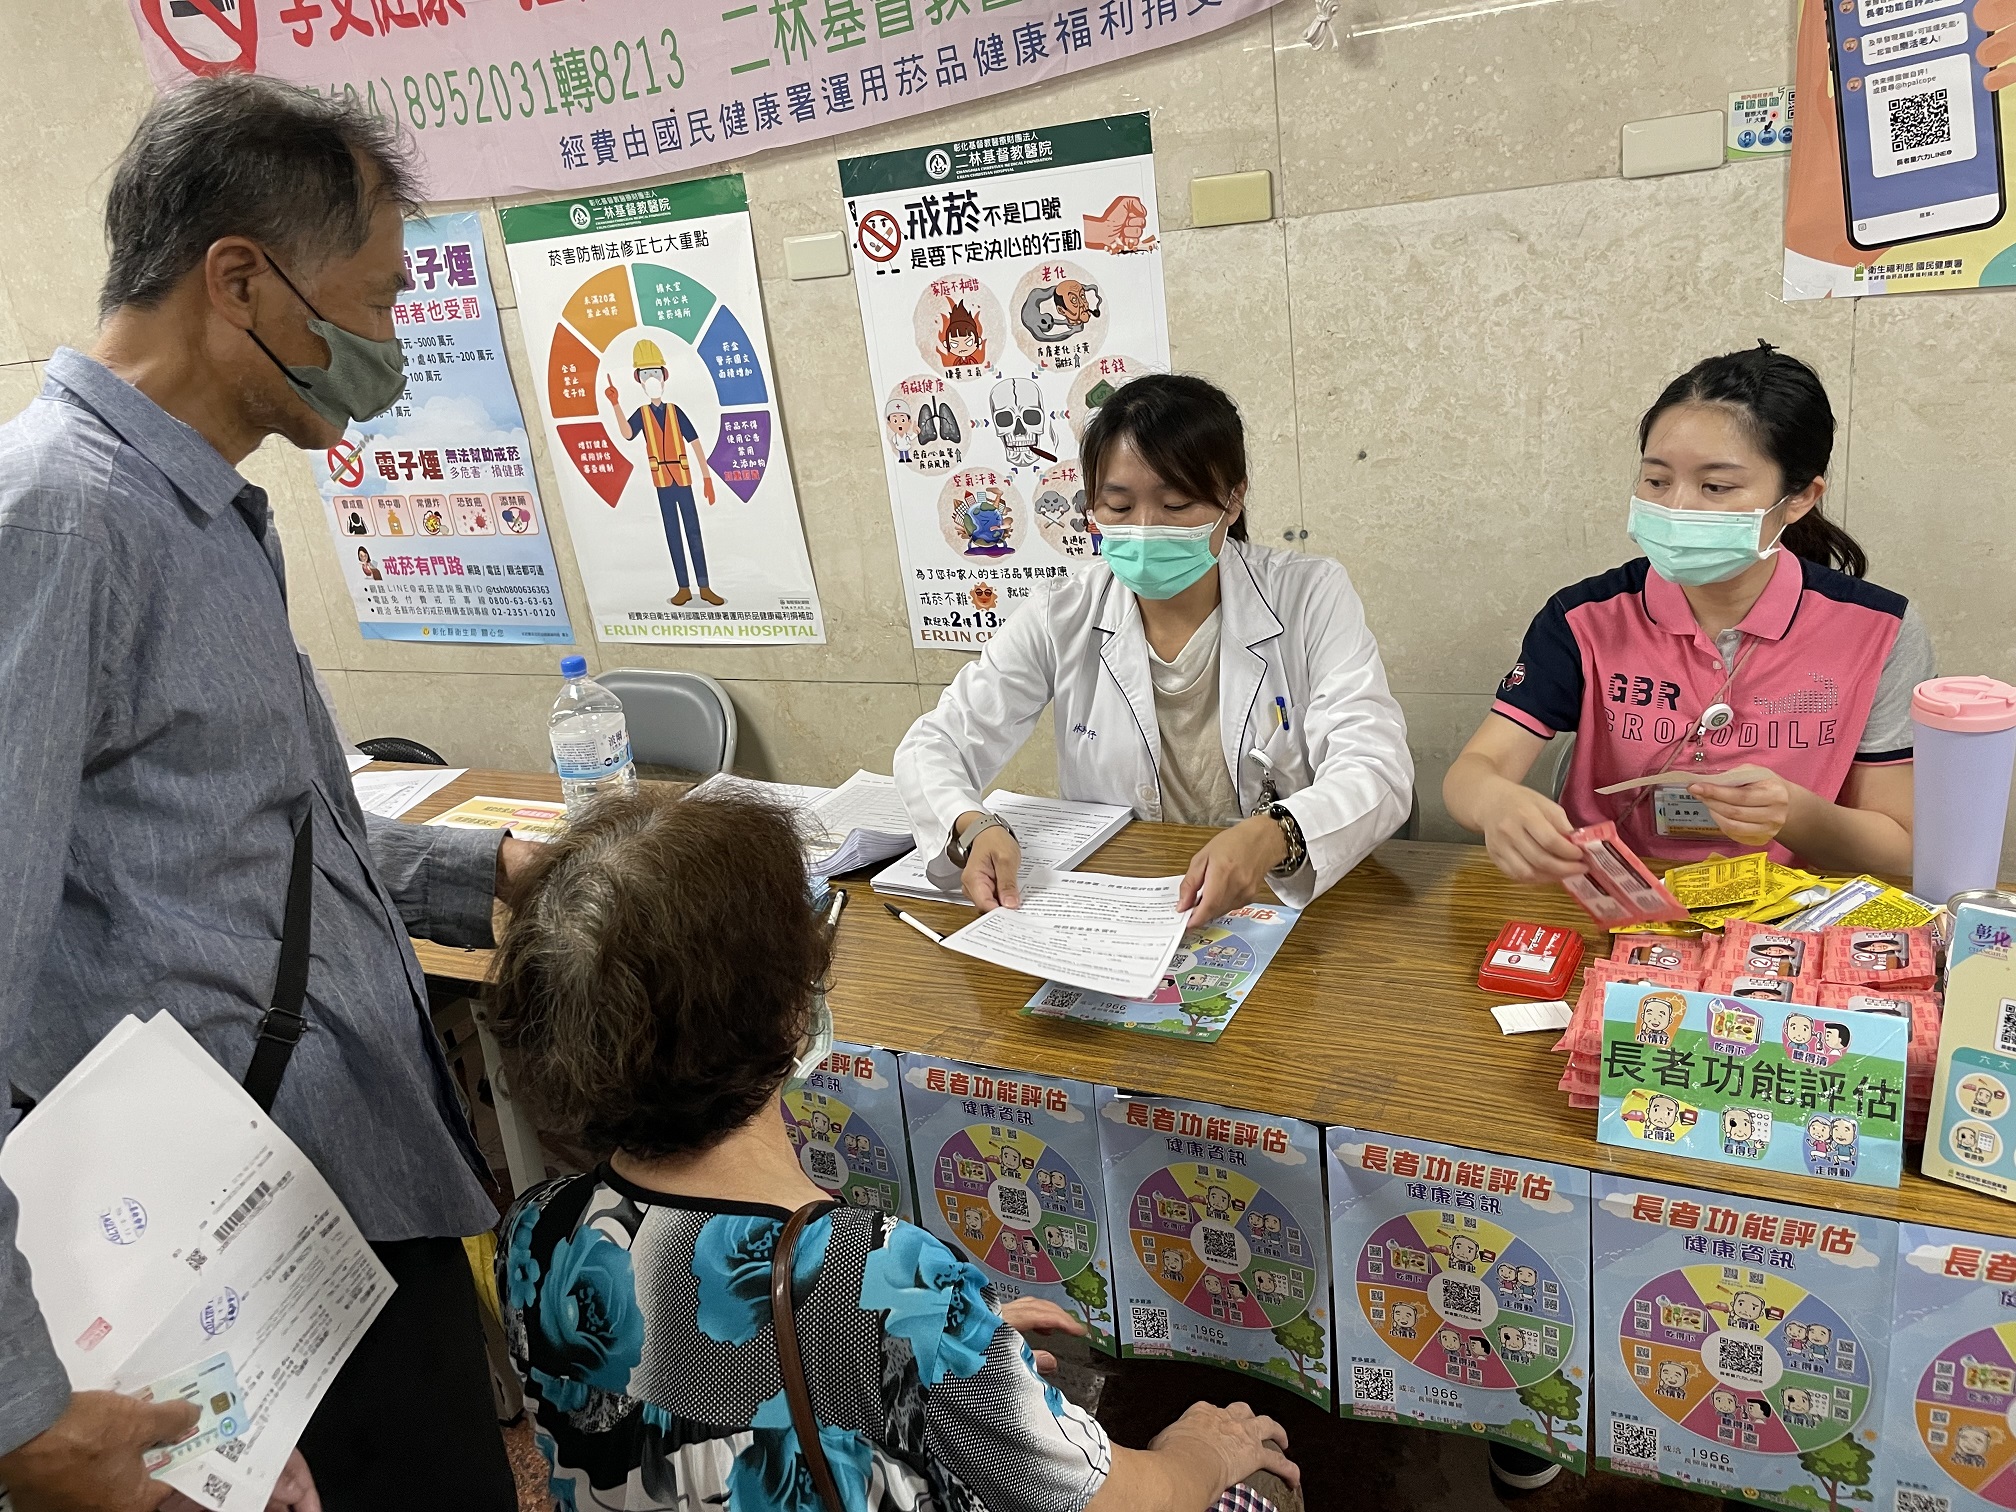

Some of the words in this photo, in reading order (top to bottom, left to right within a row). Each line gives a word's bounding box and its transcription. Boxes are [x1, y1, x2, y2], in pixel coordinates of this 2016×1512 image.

[954, 140, 1054, 170] 二林基督教醫院
[592, 197, 671, 220] 二林基督教醫院
[548, 229, 710, 267] 菸害防制法修正七大重點
[910, 229, 1082, 269] 是要下定決心的行動
[1042, 266, 1066, 282] 老化
[1868, 262, 1914, 274] 衛生福利部
[1916, 259, 1963, 271] 國民健康署
[930, 278, 980, 296] 家庭不和諧
[392, 297, 481, 325] 用者也受罰
[427, 353, 437, 364] 40
[1099, 358, 1127, 374] 花錢
[561, 364, 577, 374] 全面
[900, 378, 945, 395] 有礙健康
[445, 446, 521, 464] 無法幫助戒菸
[374, 449, 444, 481] 電子煙
[1051, 468, 1079, 482] 二手菸
[382, 556, 465, 576] 戒菸有門路
[488, 597, 553, 605] 0800-63-63-63
[919, 592, 969, 607] 戒菸不難
[491, 608, 556, 617] 02-2351-0120
[604, 625, 648, 636] ERLIN
[651, 625, 734, 637] CHRISTIAN
[738, 625, 818, 637] HOSPITAL
[920, 629, 972, 643] ERLIN
[1608, 673, 1681, 711] GBR
[1976, 924, 2011, 947] 彰化
[1100, 1002, 1128, 1011] 1966
[1636, 1032, 1670, 1046] 心情好
[1713, 1041, 1747, 1056] 吃得下
[1792, 1049, 1828, 1066] 聽得清
[1979, 1055, 2011, 1070] 六大
[1604, 1038, 1901, 1122] 長者功能評估
[926, 1067, 1069, 1113] 長者功能評估
[961, 1100, 1034, 1126] 健康資訊
[1126, 1102, 1288, 1155] 長者功能評估
[1642, 1129, 1676, 1141] 記得起
[1165, 1136, 1247, 1167] 健康資訊
[1723, 1144, 1758, 1158] 看得見
[1361, 1143, 1554, 1202] 長者功能評估
[1815, 1166, 1850, 1178] 走得動
[1405, 1181, 1503, 1215] 健康資訊
[1632, 1194, 1857, 1256] 長者功能評估
[1682, 1234, 1796, 1270] 健康資訊
[1944, 1246, 2016, 1284] 長者
[1194, 1324, 1224, 1339] 1966
[1423, 1385, 1459, 1400] 1966
[1691, 1447, 1730, 1464] 1966
